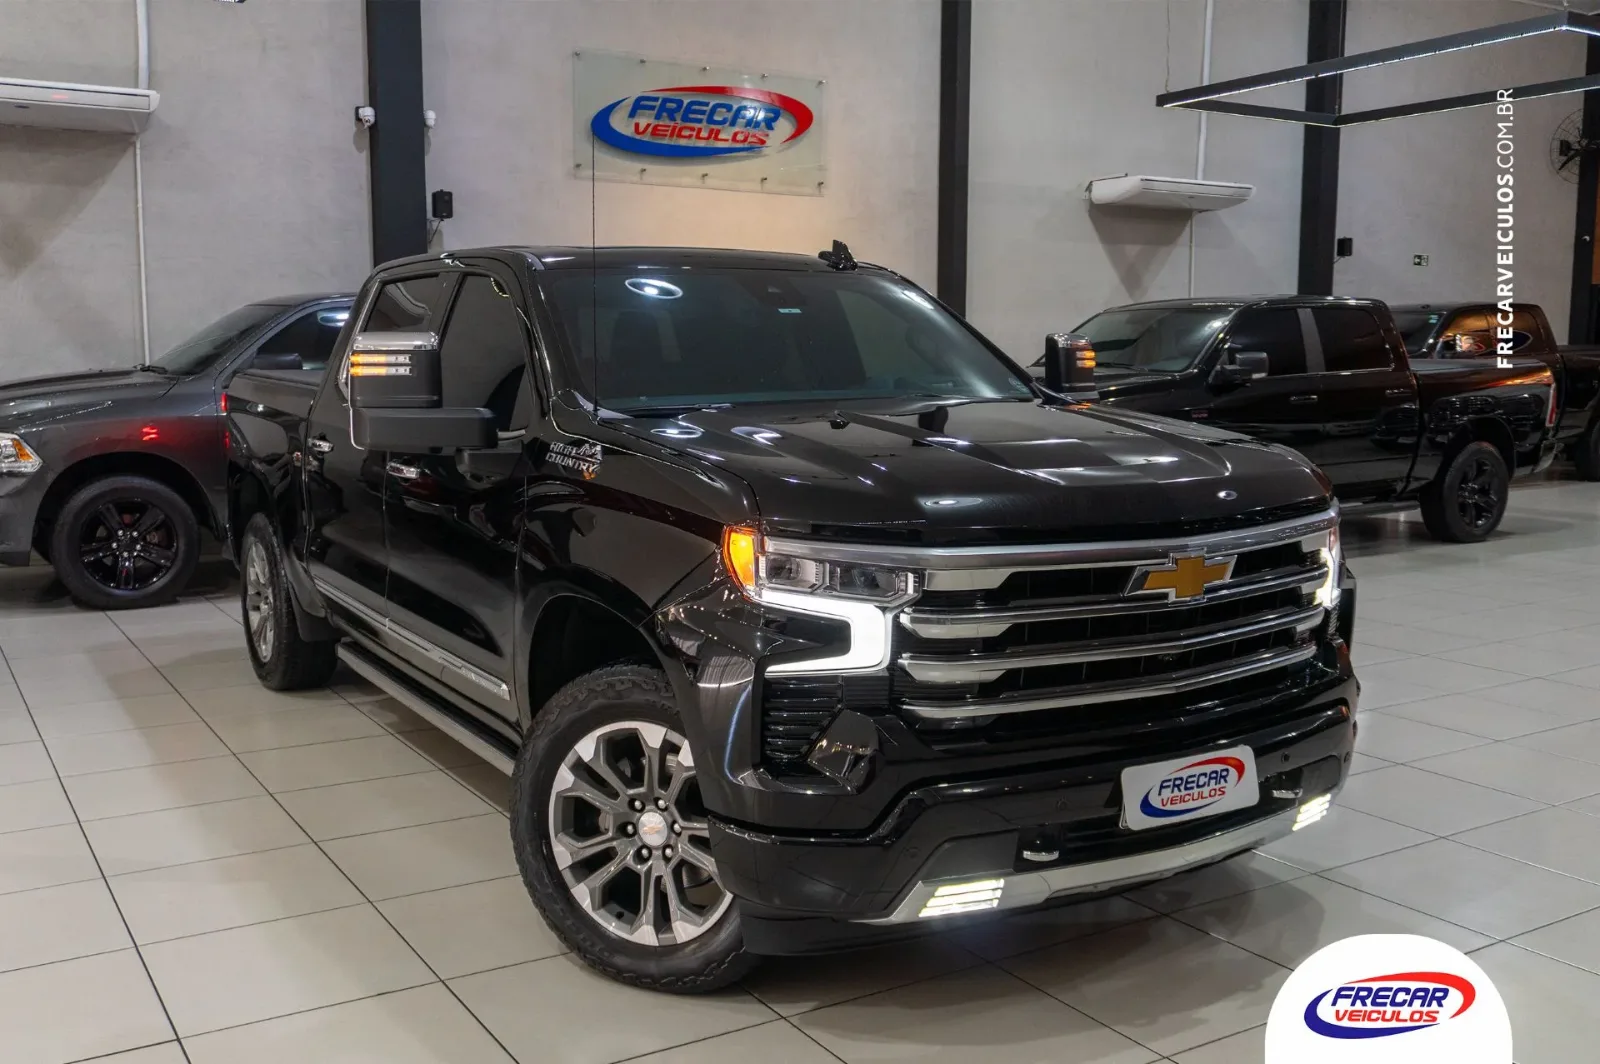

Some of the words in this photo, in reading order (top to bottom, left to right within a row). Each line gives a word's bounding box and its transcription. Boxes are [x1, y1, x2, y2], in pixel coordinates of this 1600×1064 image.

[627, 95, 782, 131] FRECAR
[545, 451, 601, 475] COUNTRY
[1157, 768, 1230, 797] FRECAR
[1161, 786, 1227, 807] VEICULOS
